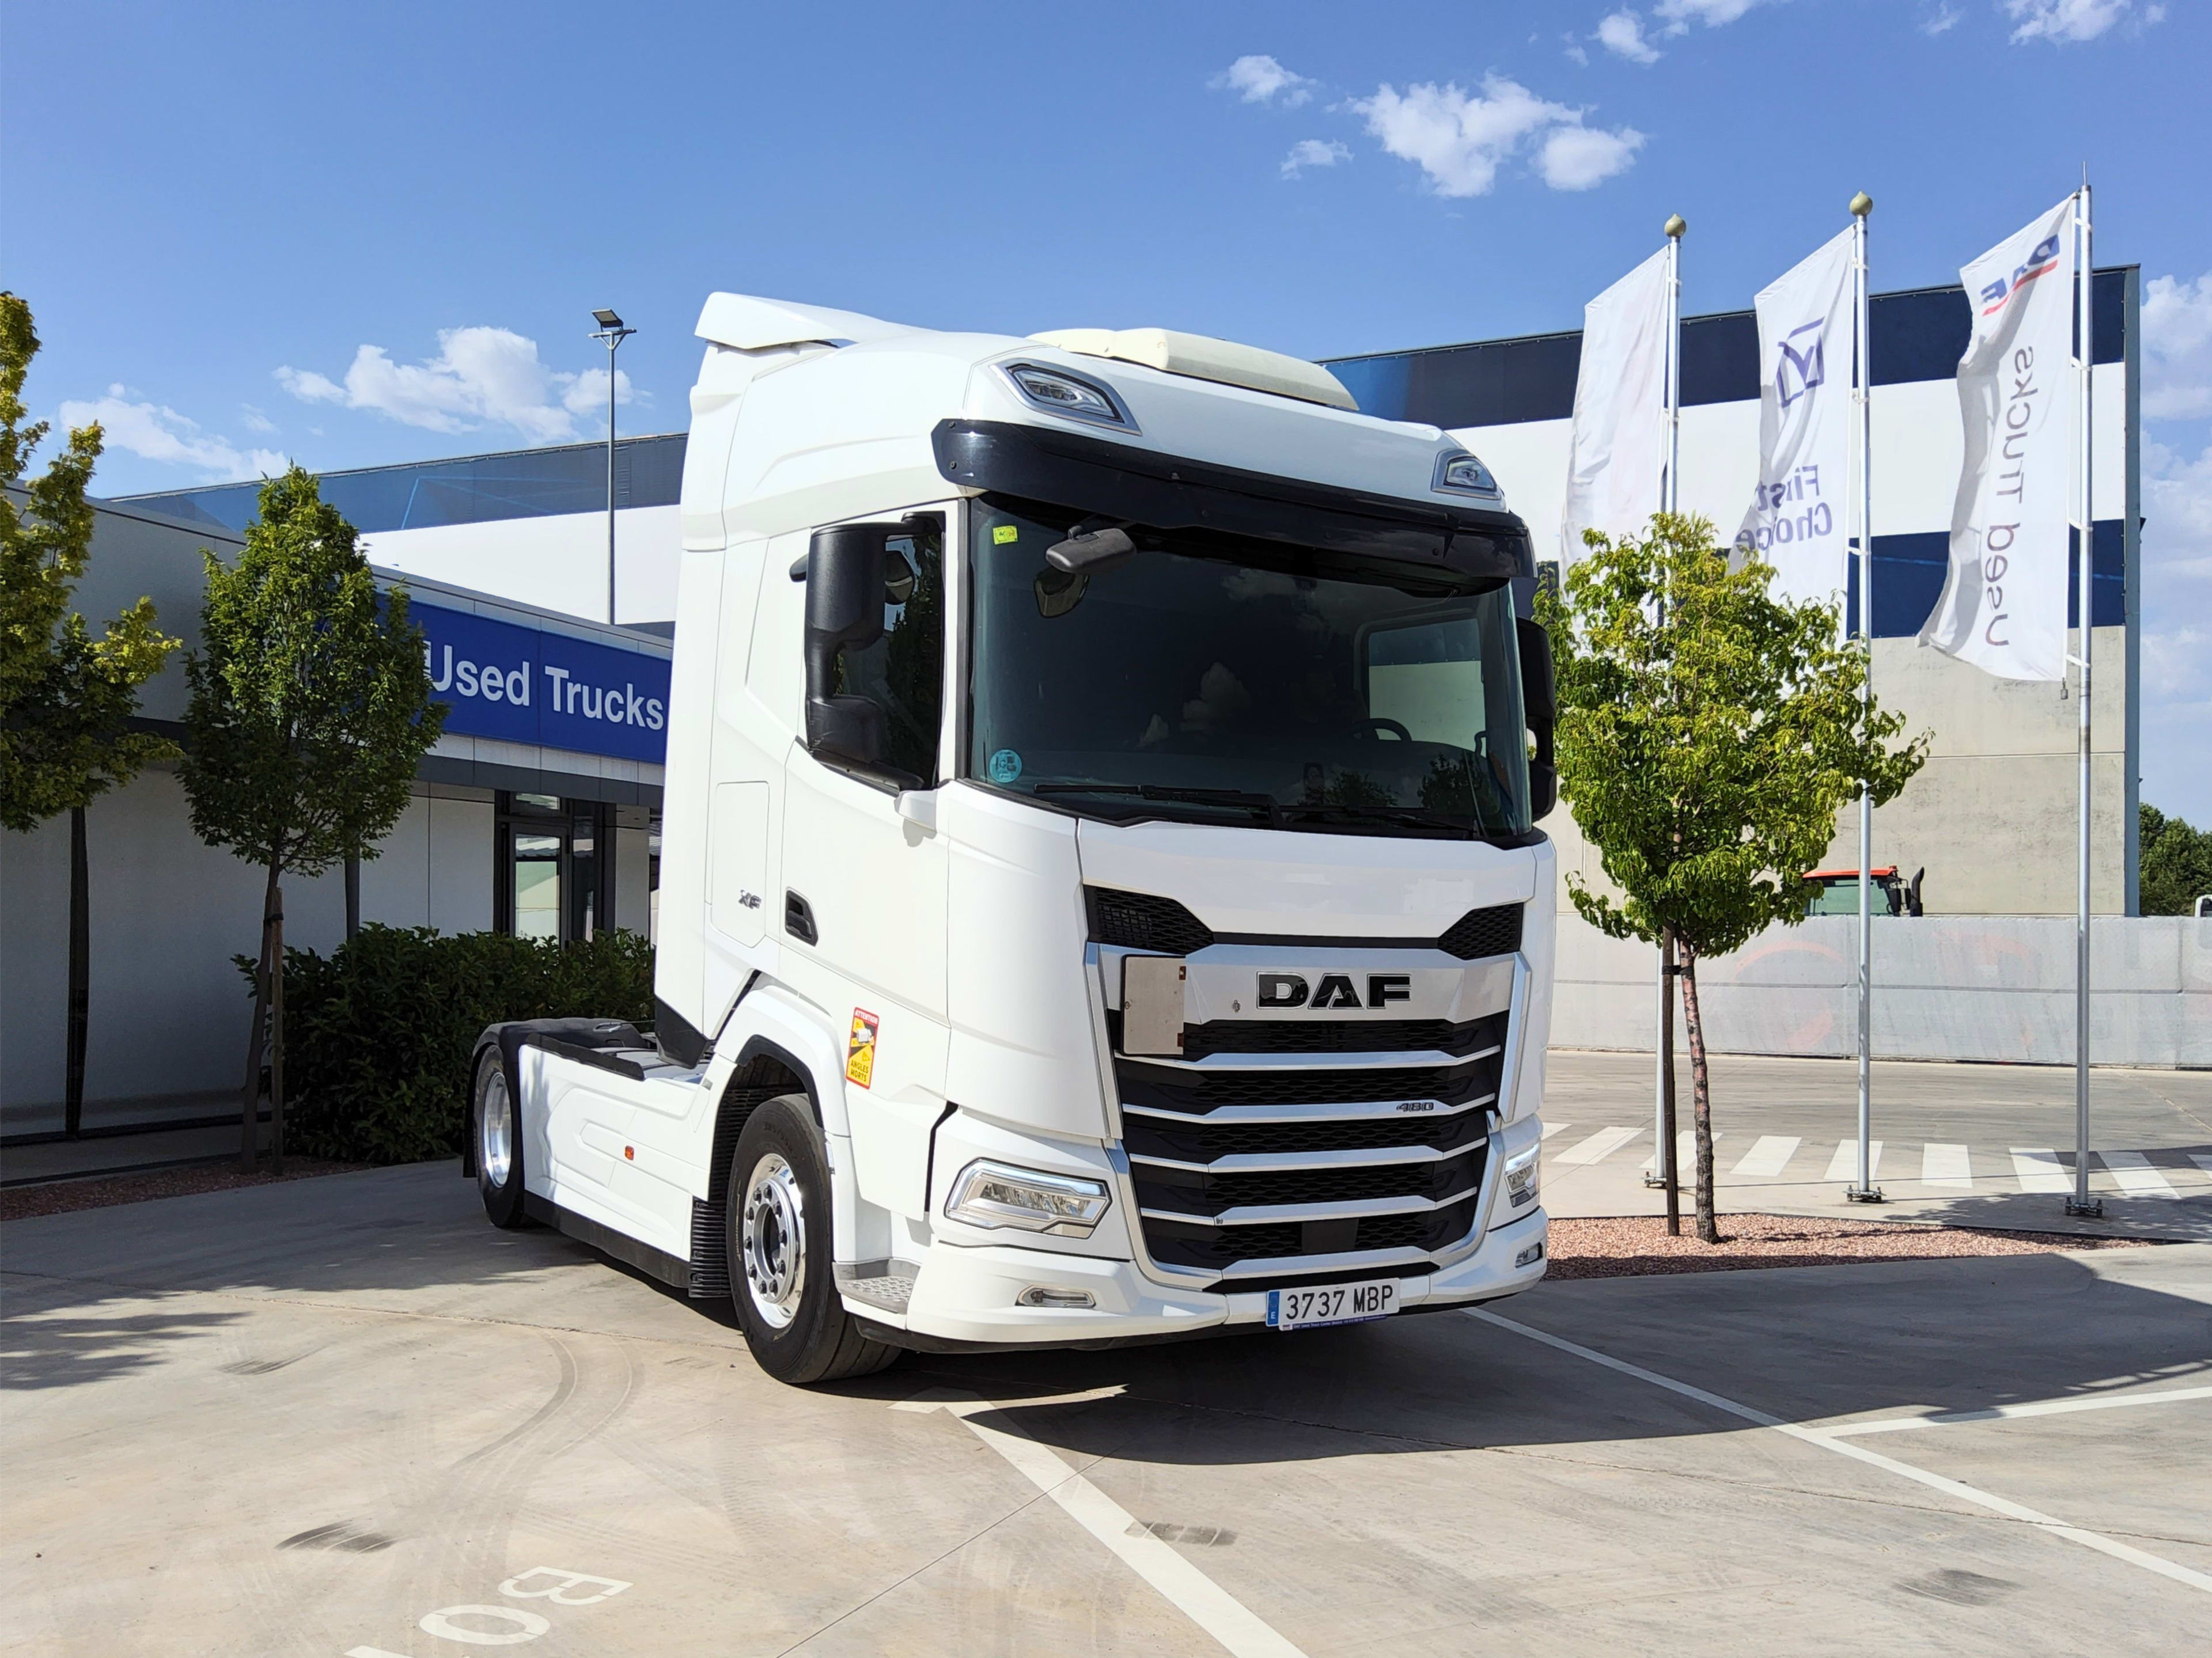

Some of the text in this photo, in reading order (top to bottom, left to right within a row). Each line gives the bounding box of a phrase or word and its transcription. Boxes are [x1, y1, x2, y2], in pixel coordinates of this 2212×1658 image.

[424, 640, 664, 730] Used Trucks
[1256, 971, 1411, 1010] DAF
[855, 1010, 877, 1025] ATTENTION
[850, 1060, 869, 1074] ANGLES
[850, 1068, 867, 1082] MORTS
[1396, 1102, 1434, 1113] 480
[1286, 1285, 1393, 1320] 3737 MBP
[1270, 1311, 1276, 1319] E
[343, 1565, 634, 1658] BO
